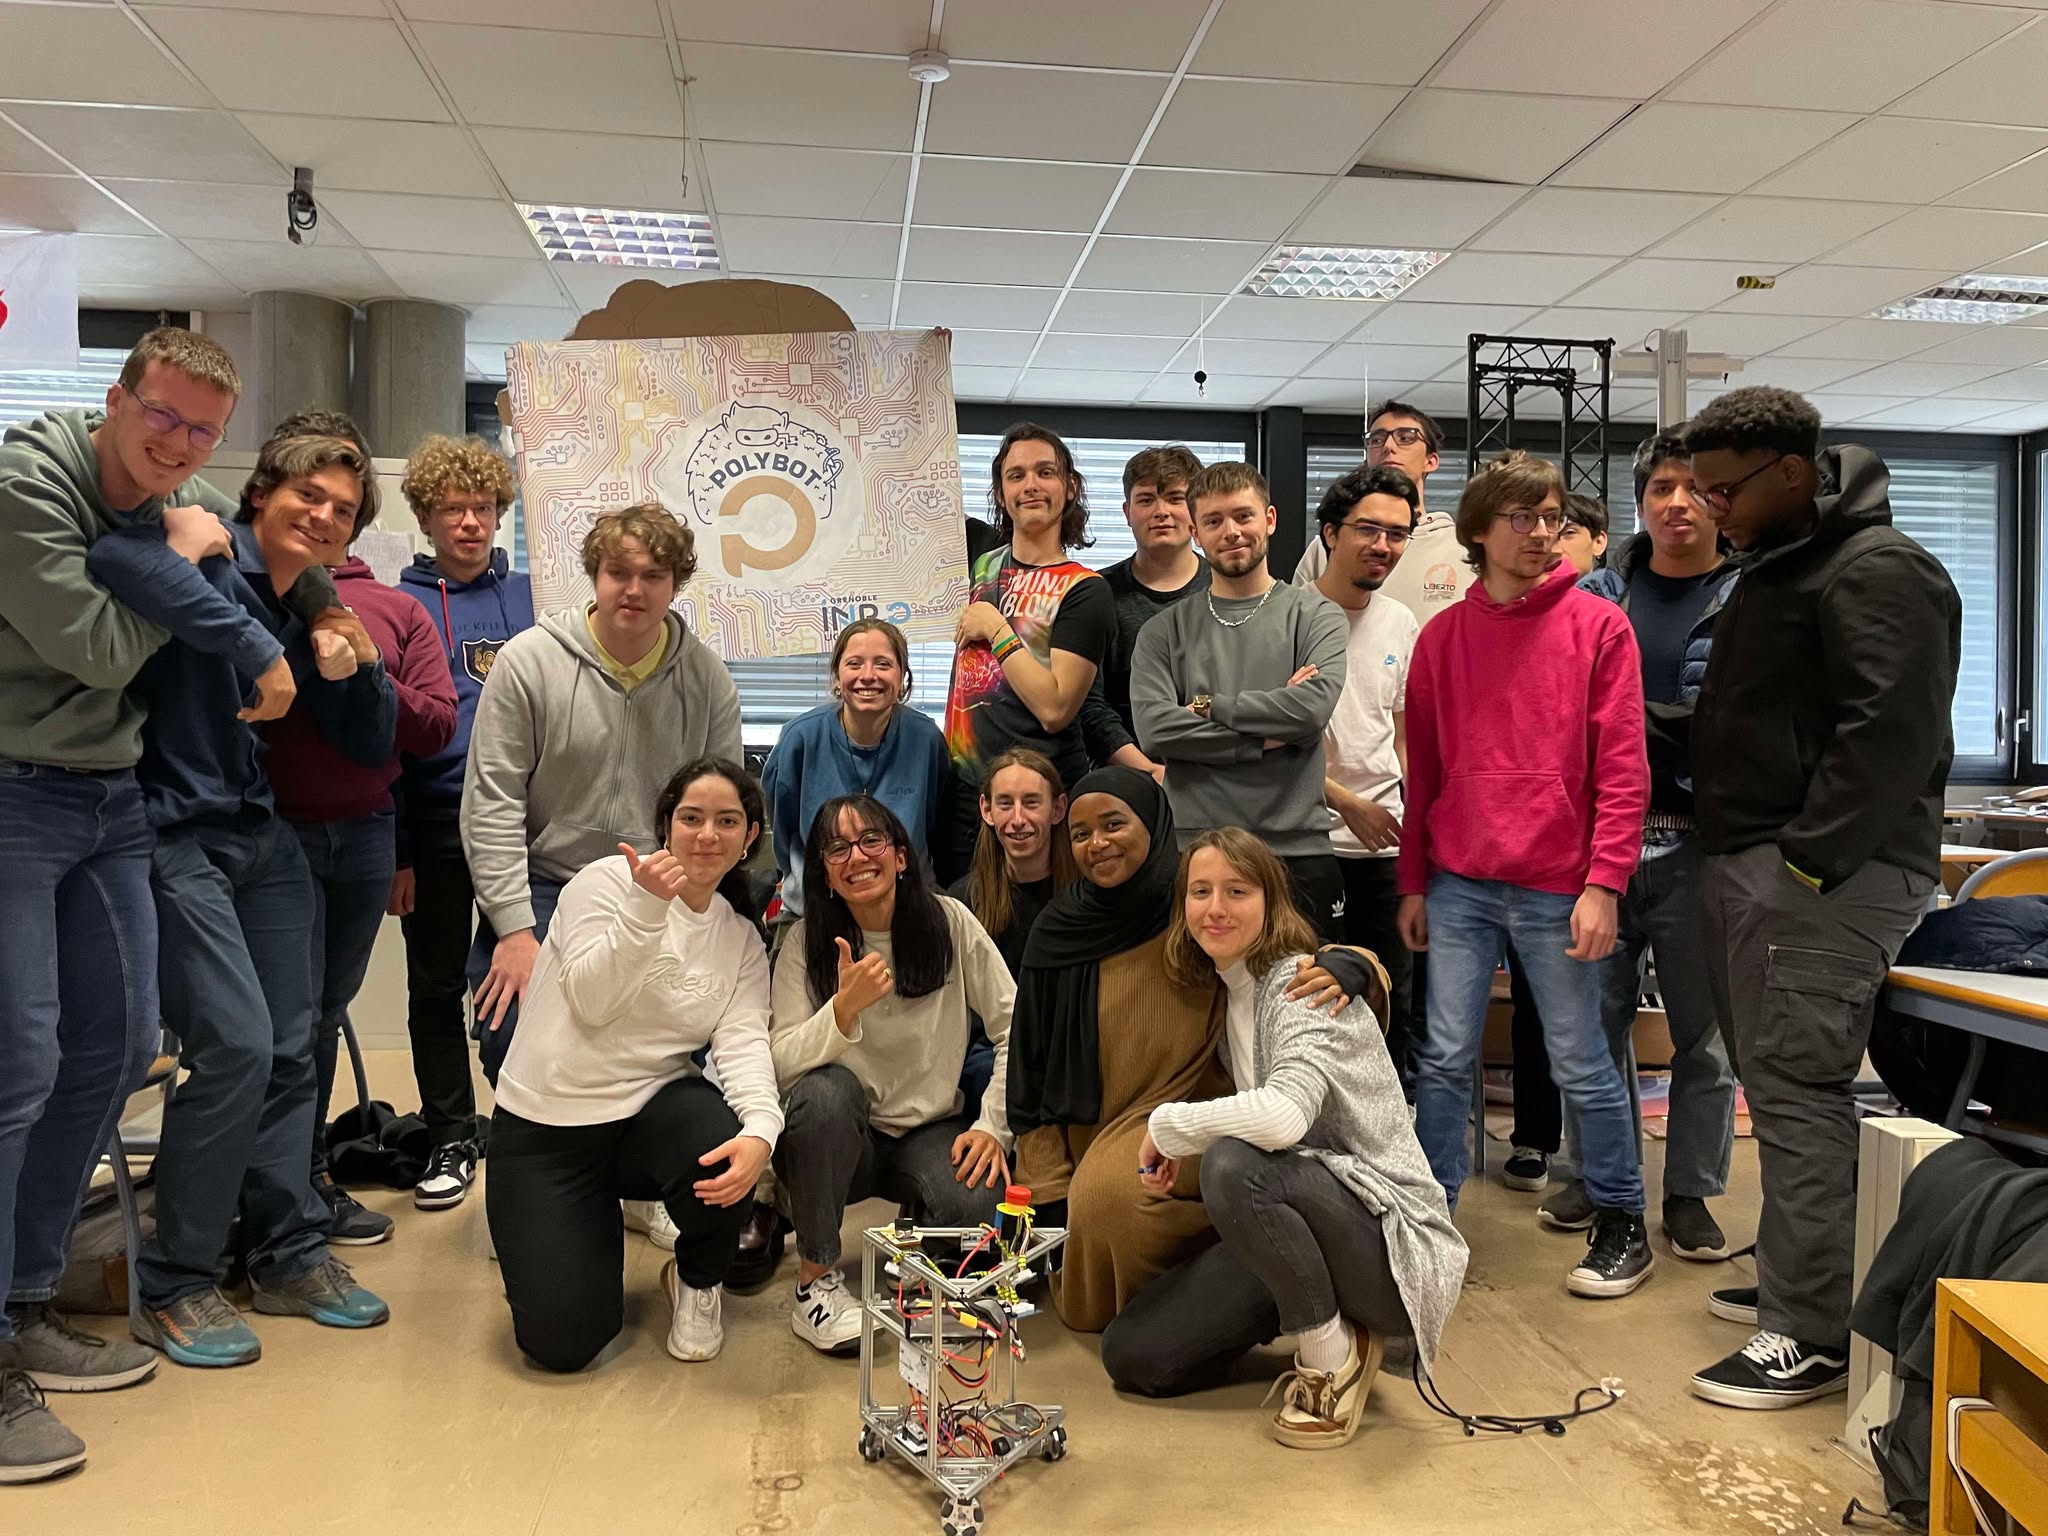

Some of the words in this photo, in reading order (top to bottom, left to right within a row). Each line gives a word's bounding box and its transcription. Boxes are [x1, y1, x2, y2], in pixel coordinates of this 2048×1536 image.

[709, 452, 823, 490] POLYBOT
[830, 594, 877, 604] GRENOBLE
[444, 620, 519, 635] UCKFIED
